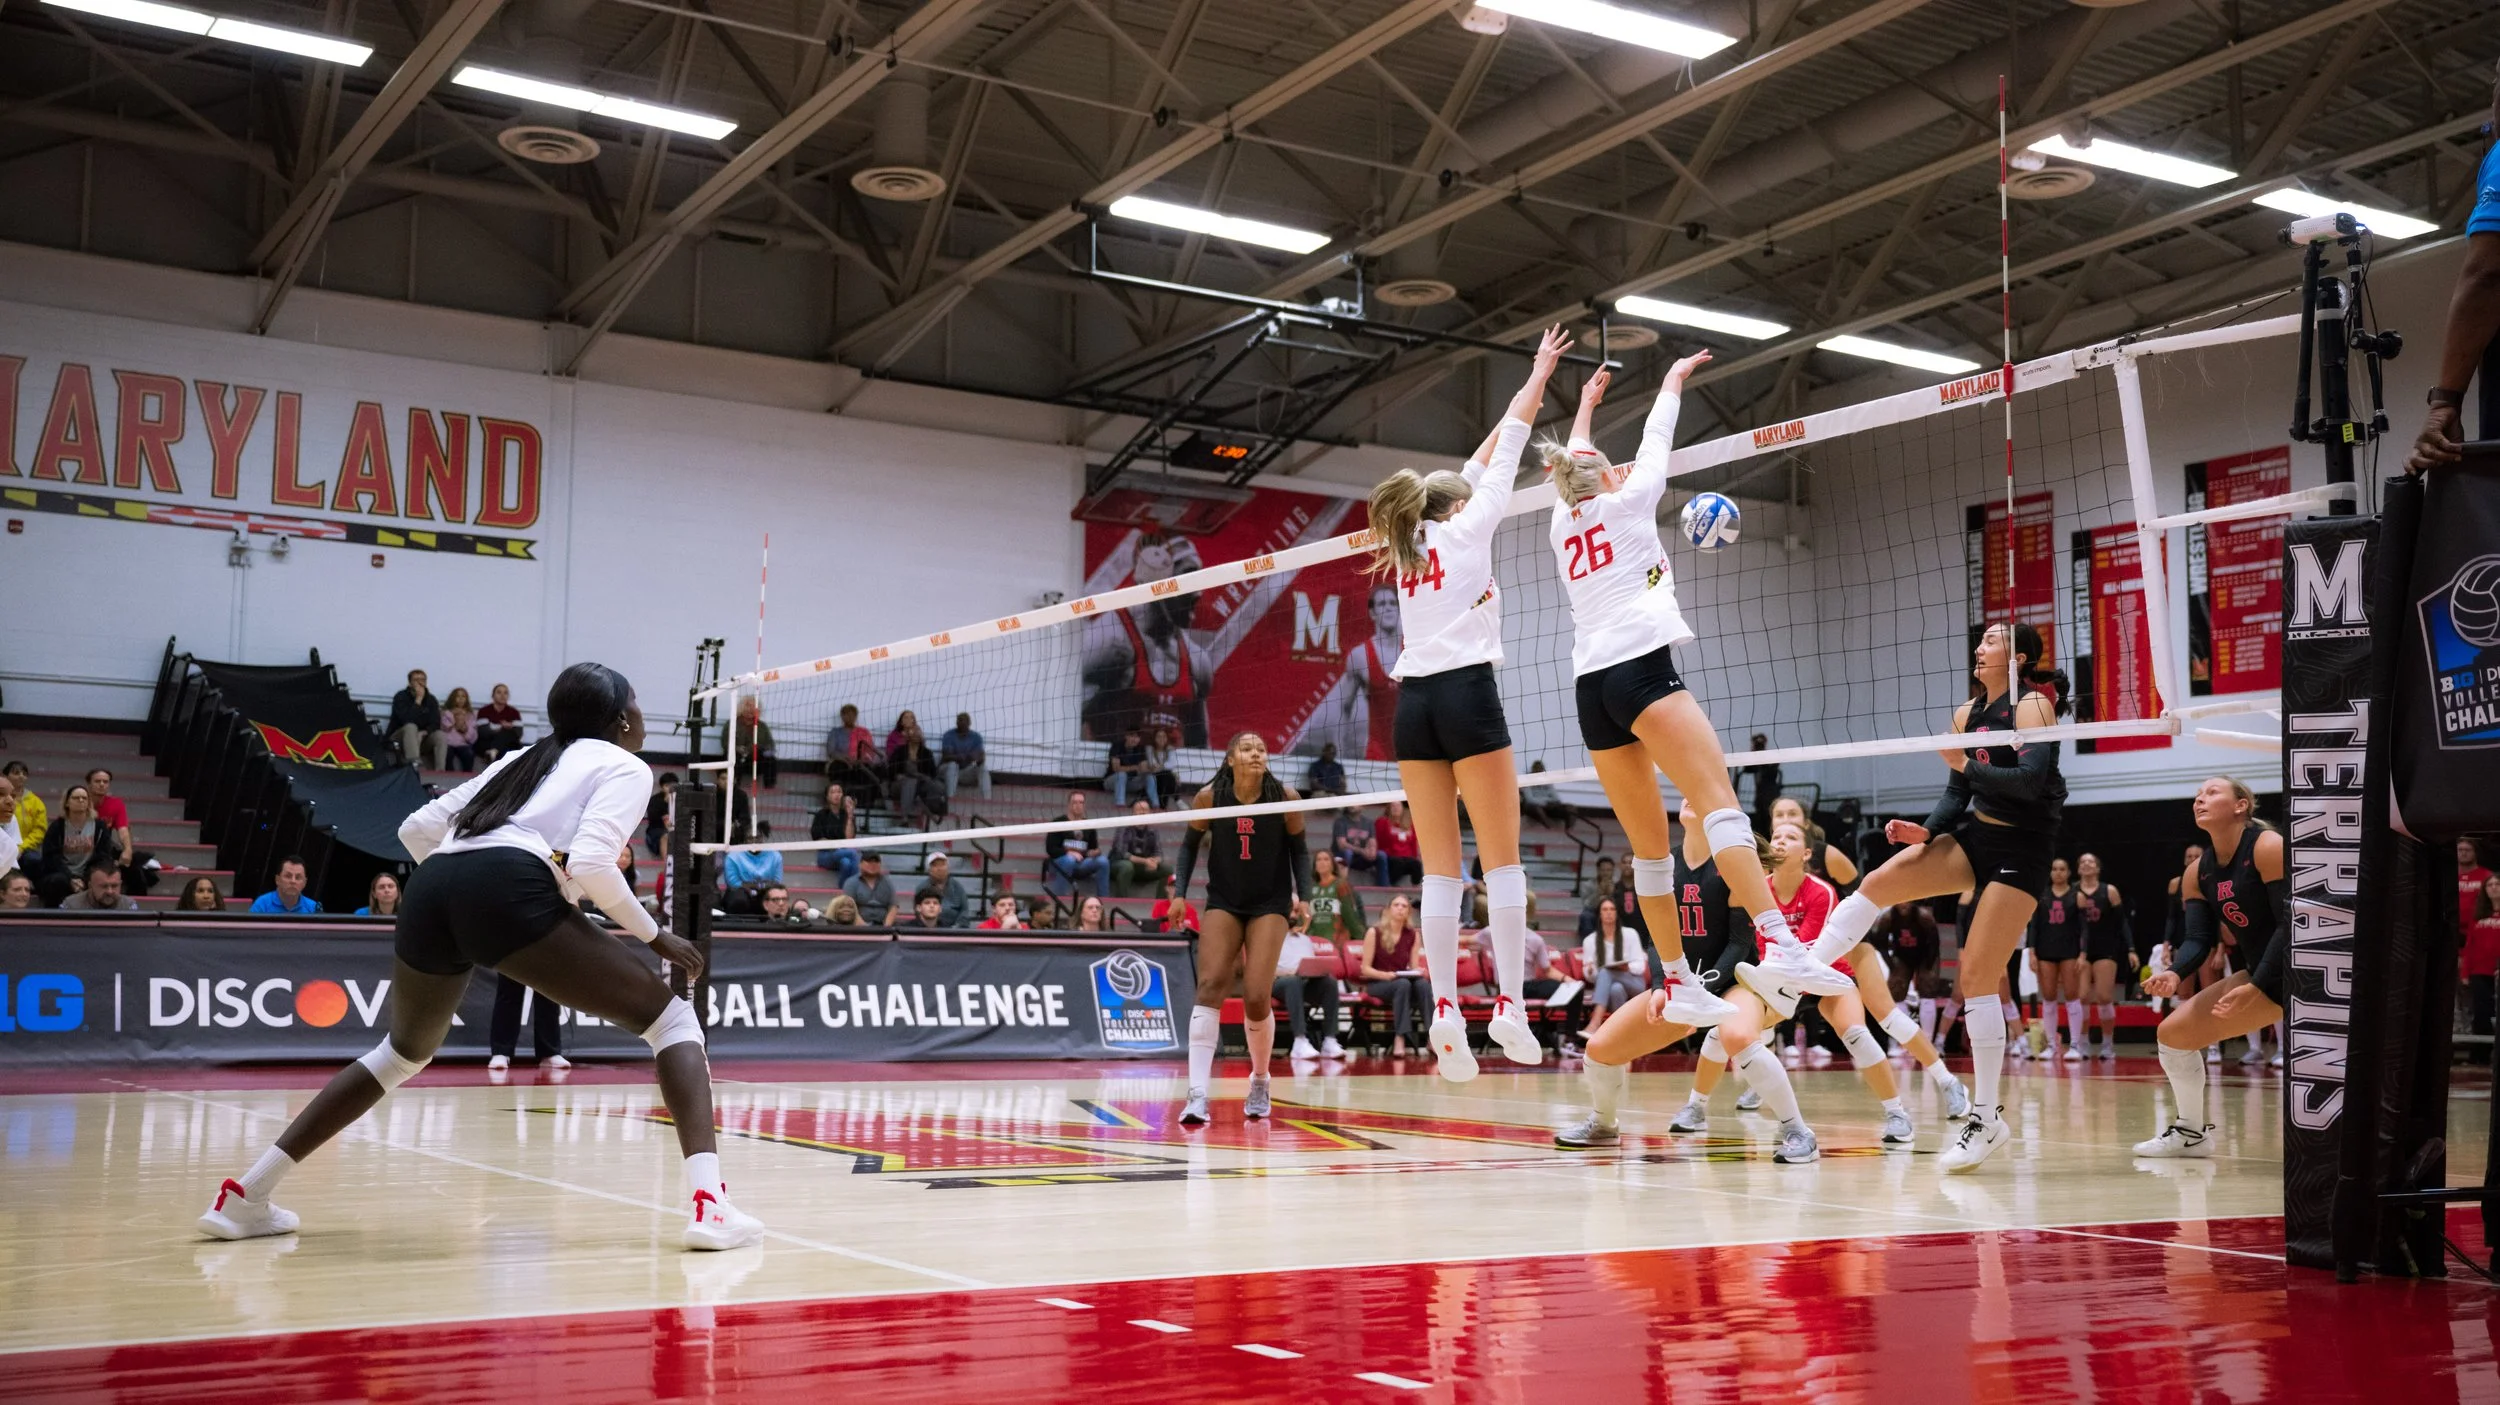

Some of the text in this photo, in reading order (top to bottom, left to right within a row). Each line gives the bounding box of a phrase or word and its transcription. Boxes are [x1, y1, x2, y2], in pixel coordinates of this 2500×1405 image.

[1939, 371, 2000, 401] MARYLAND
[1753, 420, 1805, 446] MARYLAND
[1564, 523, 1614, 581] 26
[1400, 547, 1445, 597] 44
[2289, 539, 2369, 628] M
[1292, 591, 1342, 654] M
[1237, 817, 1255, 834] R
[1240, 835, 1252, 860] 1
[1682, 884, 1702, 902] R
[2217, 880, 2235, 902] R
[1680, 906, 1707, 936] 11
[2222, 901, 2249, 928] 6
[2289, 698, 2371, 1130] TERRAPINS
[149, 977, 464, 1028] DISCOV
[817, 984, 1069, 1028] CHALLENGE
[1128, 1009, 1166, 1019] DISCOVER
[1104, 1019, 1169, 1029] VOLLEYBALL
[1106, 1028, 1172, 1041] CHALLENGE
